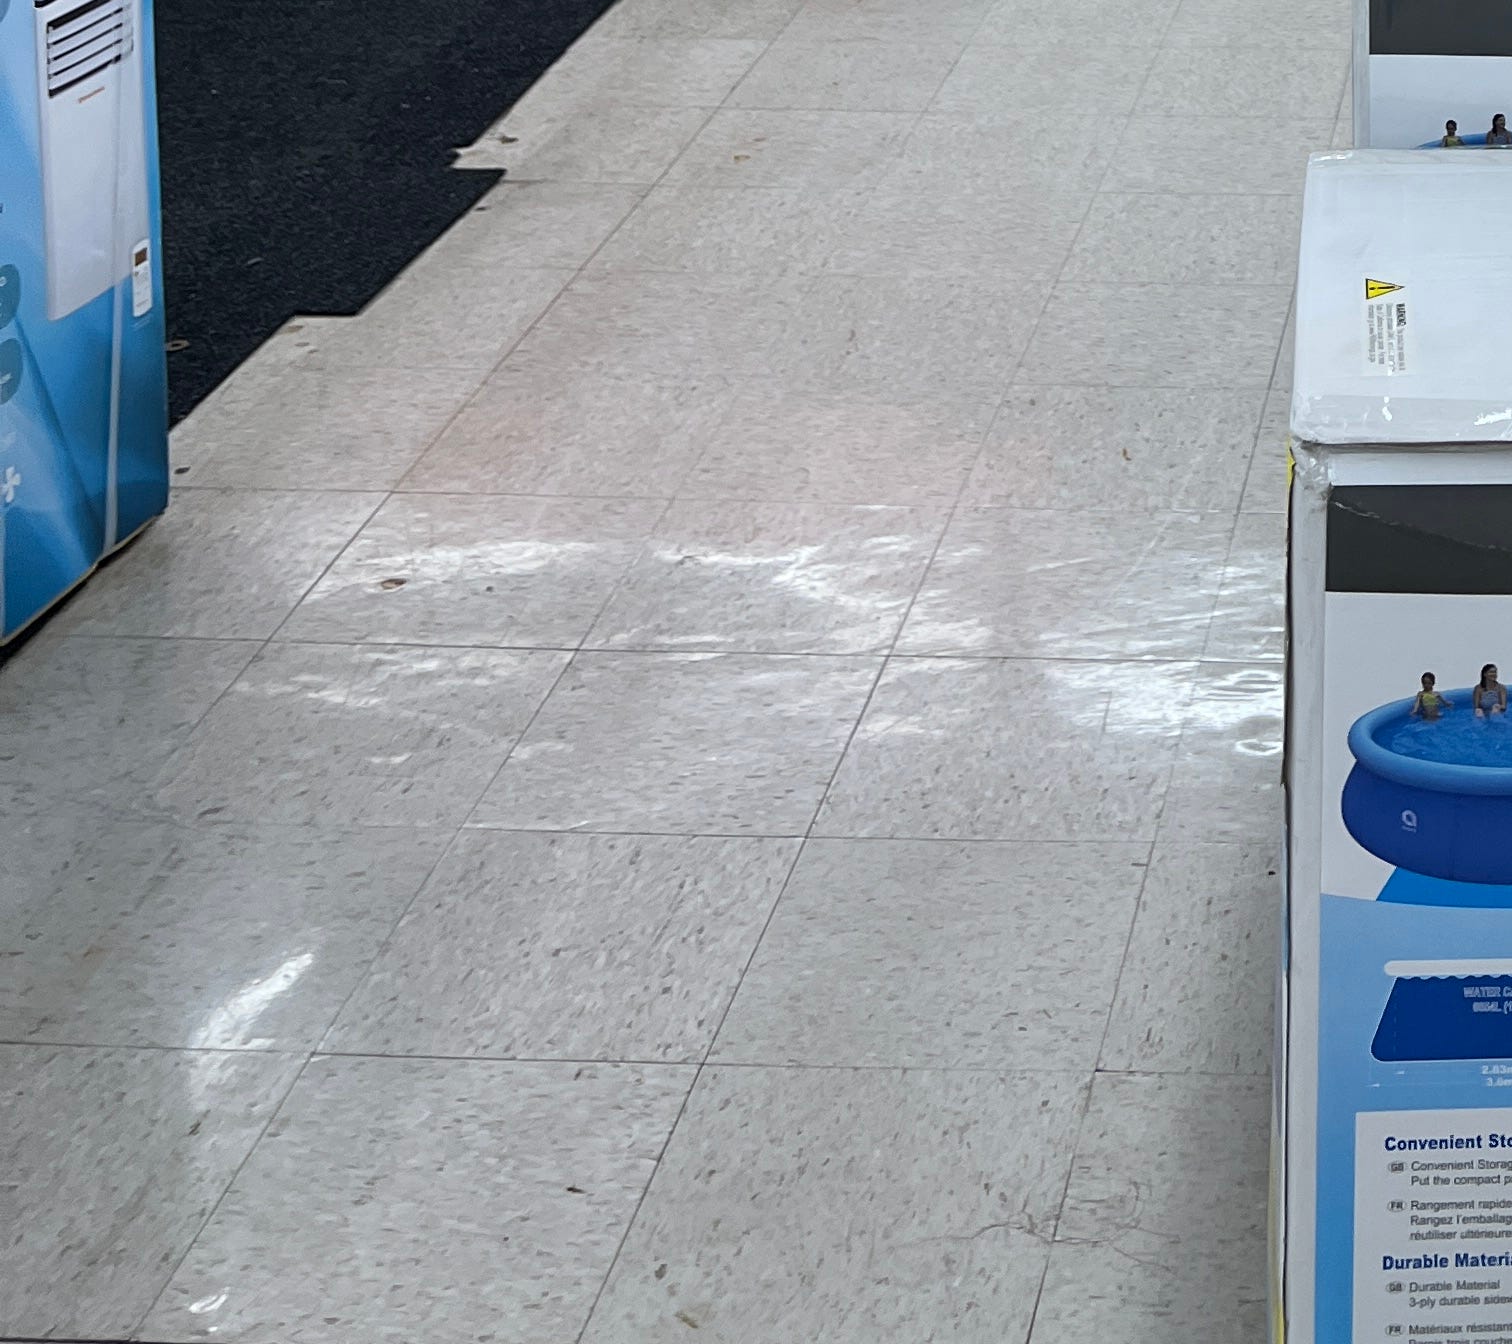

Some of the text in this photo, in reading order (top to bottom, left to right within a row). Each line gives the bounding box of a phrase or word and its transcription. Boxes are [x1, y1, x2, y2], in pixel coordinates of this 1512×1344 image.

[1463, 986, 1500, 998] WATER
[1384, 1134, 1482, 1151] Convenient
[1411, 1160, 1474, 1172] Convenient
[1411, 1175, 1429, 1186] Put
[1433, 1175, 1450, 1185] the
[1454, 1174, 1501, 1186] compact
[1410, 1199, 1474, 1212] Rangement
[1410, 1215, 1453, 1228] Rangez
[1382, 1253, 1449, 1271] Durable
[1409, 1279, 1501, 1293] Durable Material
[1409, 1297, 1436, 1310] 3-ply
[1439, 1295, 1480, 1307] durable
[1409, 1324, 1463, 1335] Matériaux
